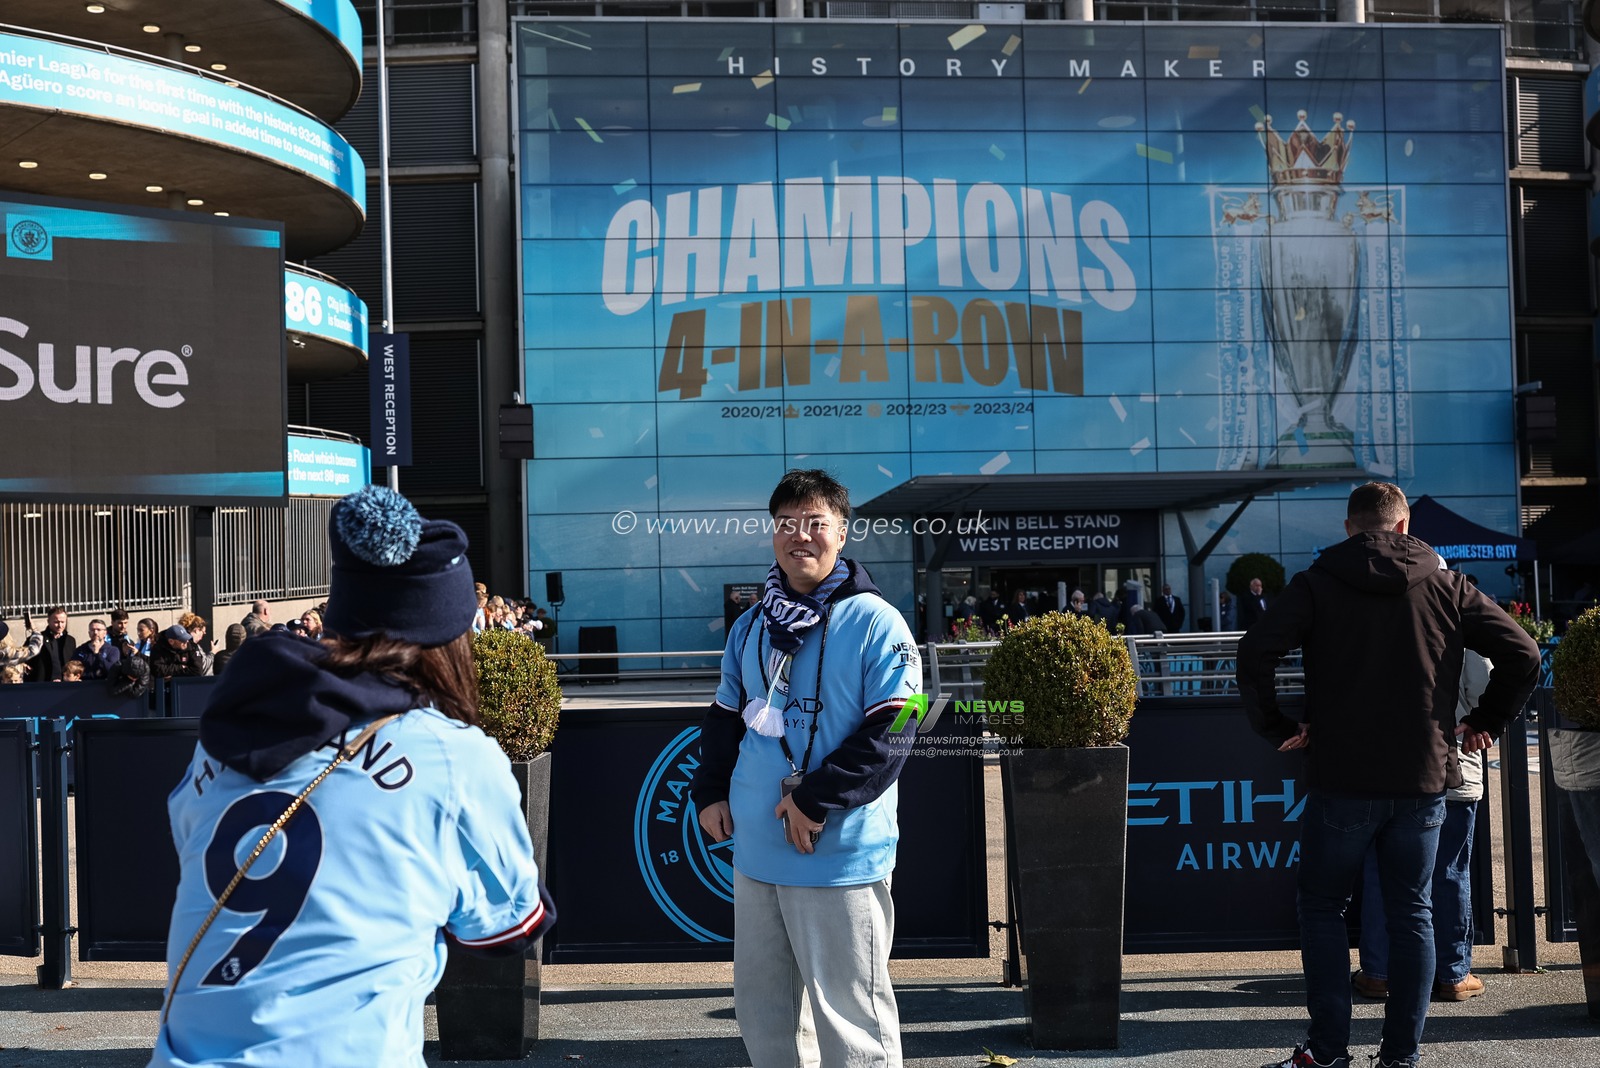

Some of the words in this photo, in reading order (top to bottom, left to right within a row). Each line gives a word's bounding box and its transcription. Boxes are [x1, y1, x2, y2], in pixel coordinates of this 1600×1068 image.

[728, 56, 1007, 77] HISTORY
[1069, 59, 1310, 78] MAKERS
[39, 55, 100, 80] League
[103, 67, 126, 86] for
[127, 73, 154, 92] the
[156, 79, 185, 100] first
[187, 88, 216, 107] time
[218, 98, 244, 117] with
[245, 105, 263, 123] the
[263, 112, 298, 137] historic
[0, 69, 62, 94] Agüero
[66, 83, 113, 103] score
[115, 93, 135, 108] an
[182, 107, 210, 124] goal
[212, 113, 223, 129] in
[225, 119, 259, 140] added
[260, 129, 282, 148] time
[282, 138, 293, 152] to
[602, 175, 1137, 315] CHAMPIONS
[285, 281, 323, 326] 86
[658, 295, 1084, 399] 4-IN-A-ROW
[383, 344, 395, 381] WEST
[721, 406, 782, 419] 2020/21
[803, 404, 863, 418] 2021/22
[886, 403, 947, 416] 2022/23
[973, 402, 1034, 415] 2023/24
[384, 384, 396, 455] RECEPTION
[293, 449, 315, 464] Road
[1016, 515, 1059, 530] BELL
[1064, 514, 1121, 529] STAND
[959, 537, 1012, 552] WEST
[1017, 535, 1119, 551] RECEPTION
[1495, 544, 1517, 558] CITY
[660, 849, 680, 865] 18
[203, 788, 326, 987] 9
